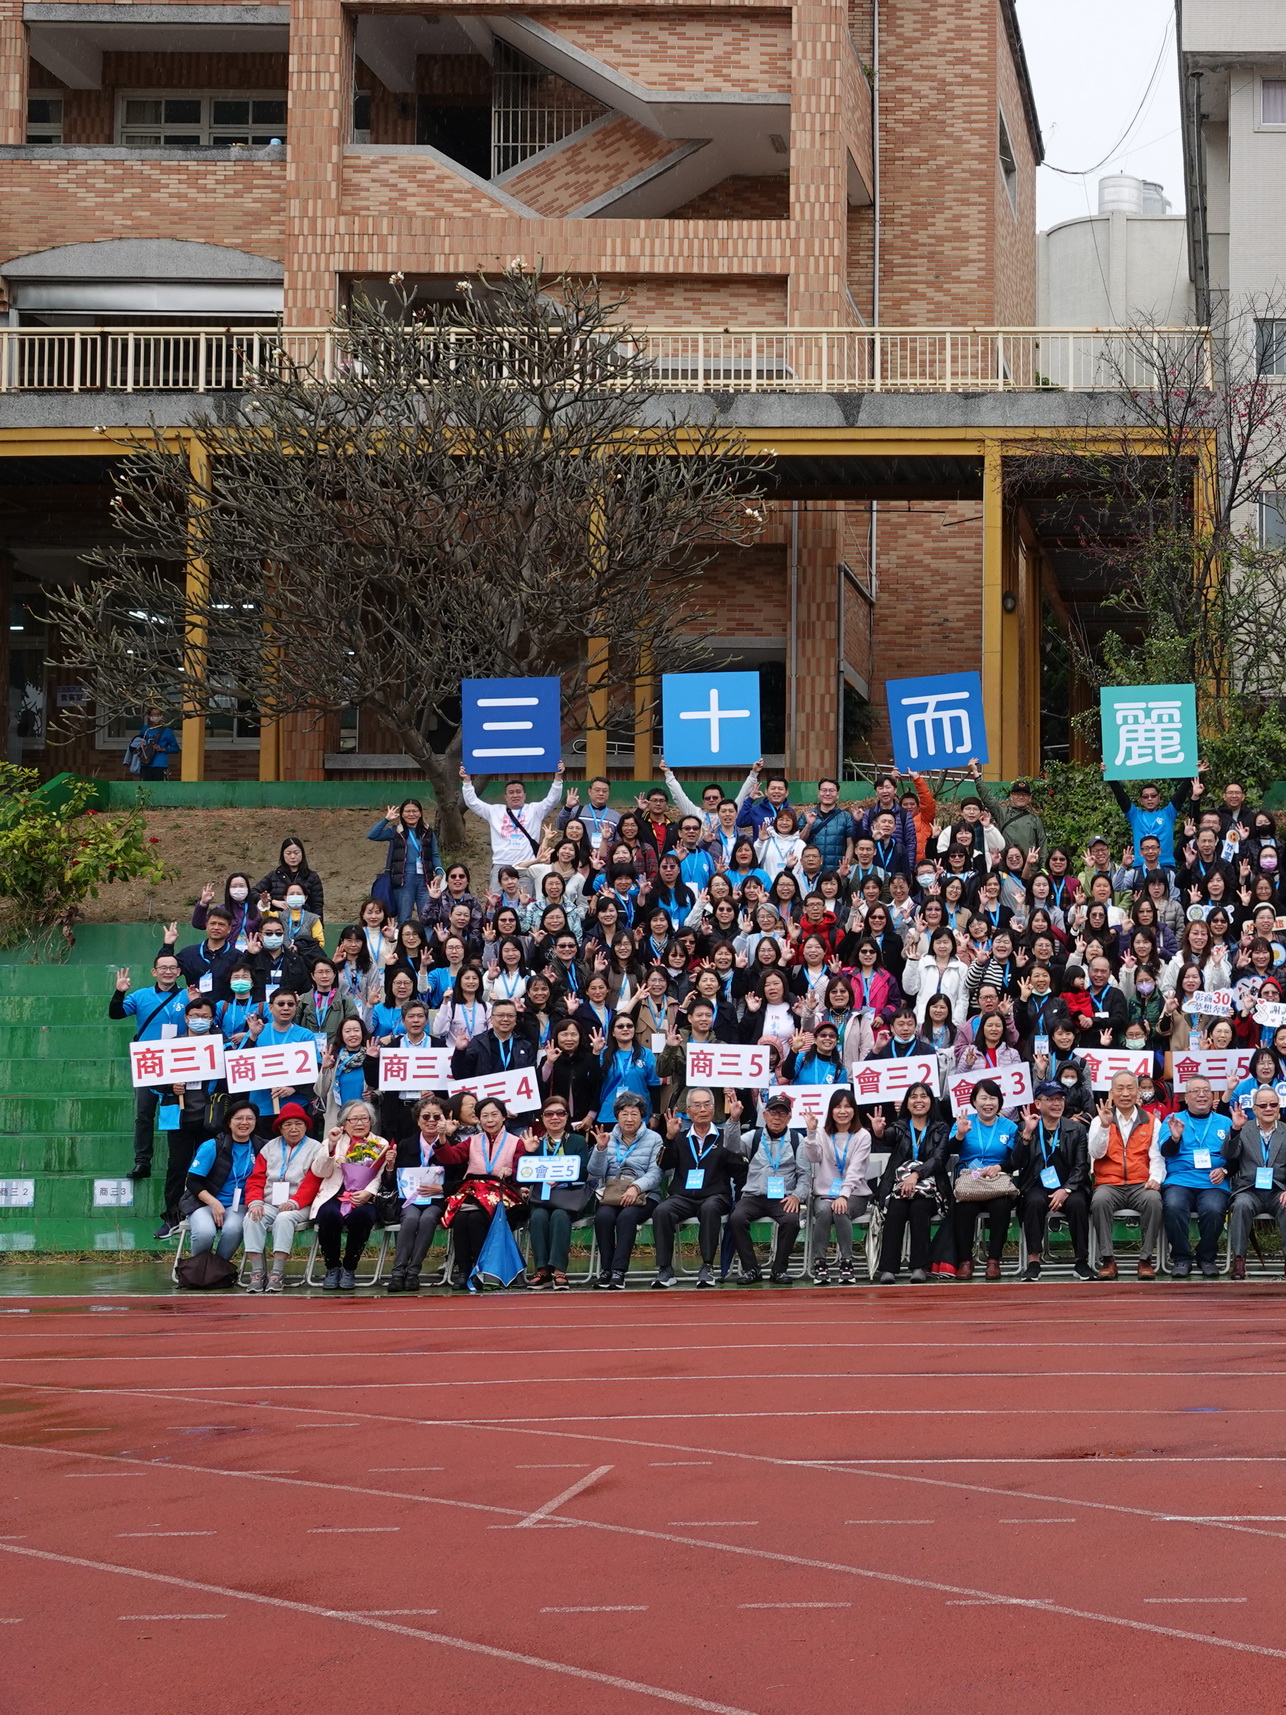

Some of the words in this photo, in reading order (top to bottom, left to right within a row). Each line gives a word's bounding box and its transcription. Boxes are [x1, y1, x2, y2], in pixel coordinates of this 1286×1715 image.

[472, 697, 545, 757] 三
[679, 688, 750, 753] 十
[901, 691, 972, 759] 而
[1113, 700, 1185, 766] 麗
[132, 1044, 216, 1080] 商三1
[228, 1049, 311, 1083] 商三2
[689, 1050, 763, 1078] 商三5
[855, 1063, 933, 1095] 會三2
[951, 1071, 1026, 1107] 會3
[535, 1164, 574, 1179] 會三5
